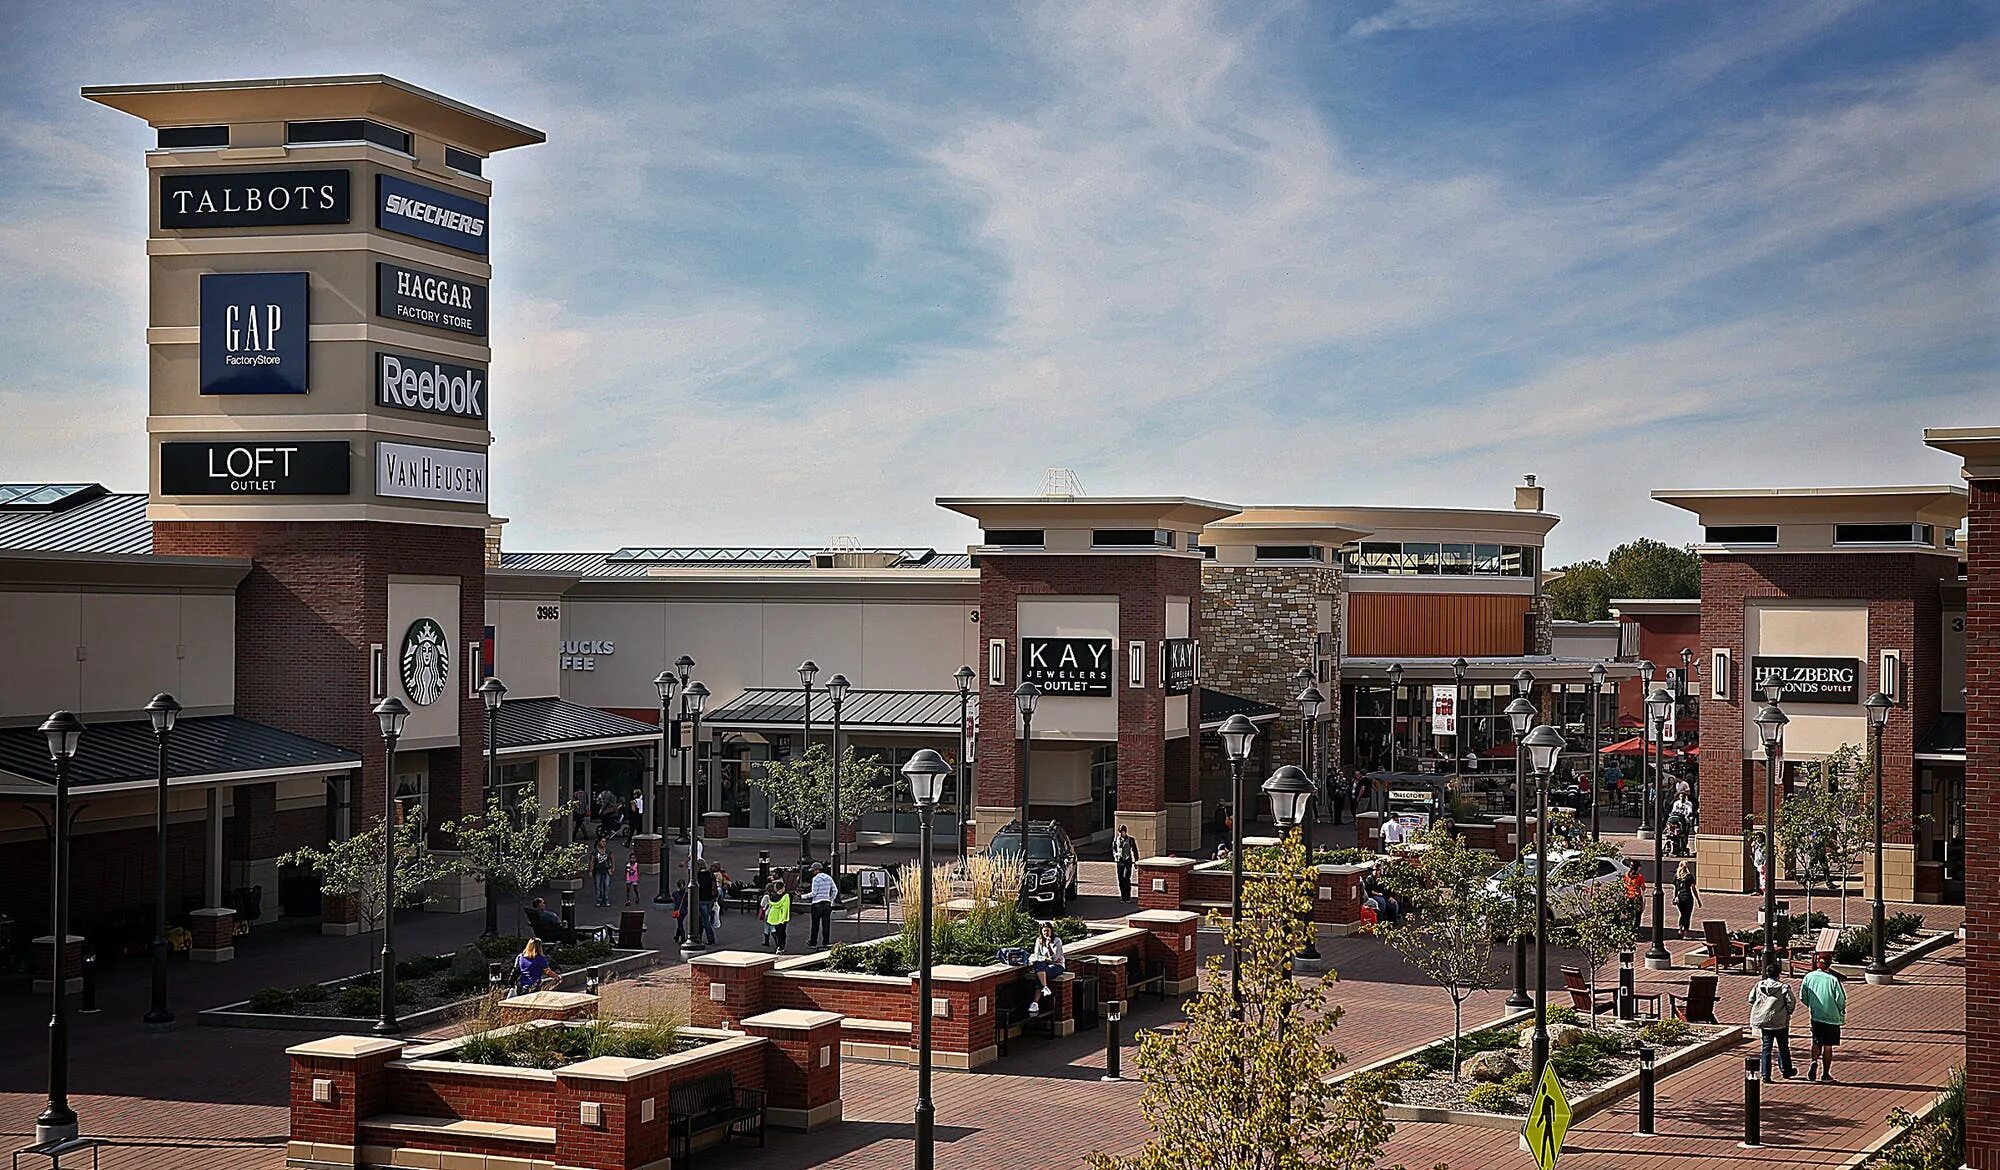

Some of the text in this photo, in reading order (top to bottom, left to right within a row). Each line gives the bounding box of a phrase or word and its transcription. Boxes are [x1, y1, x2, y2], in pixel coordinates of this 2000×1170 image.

[172, 185, 335, 214] TALBOTS
[385, 194, 485, 237] SKECHERS
[397, 271, 472, 309] HAGGAR
[226, 304, 281, 352] GAP
[397, 304, 473, 330] FACTORY STORE
[383, 355, 482, 416] Reebok
[208, 447, 298, 478] LOFT
[230, 480, 276, 491] OUTLET
[536, 605, 560, 620] 3985
[1029, 643, 1107, 668] KAY
[1171, 643, 1194, 668] KAY
[1026, 670, 1107, 680] JEWELERS
[1043, 681, 1089, 691] OUTLET
[1754, 666, 1854, 683] HELZBERG
[1755, 682, 1819, 693] DONDS
